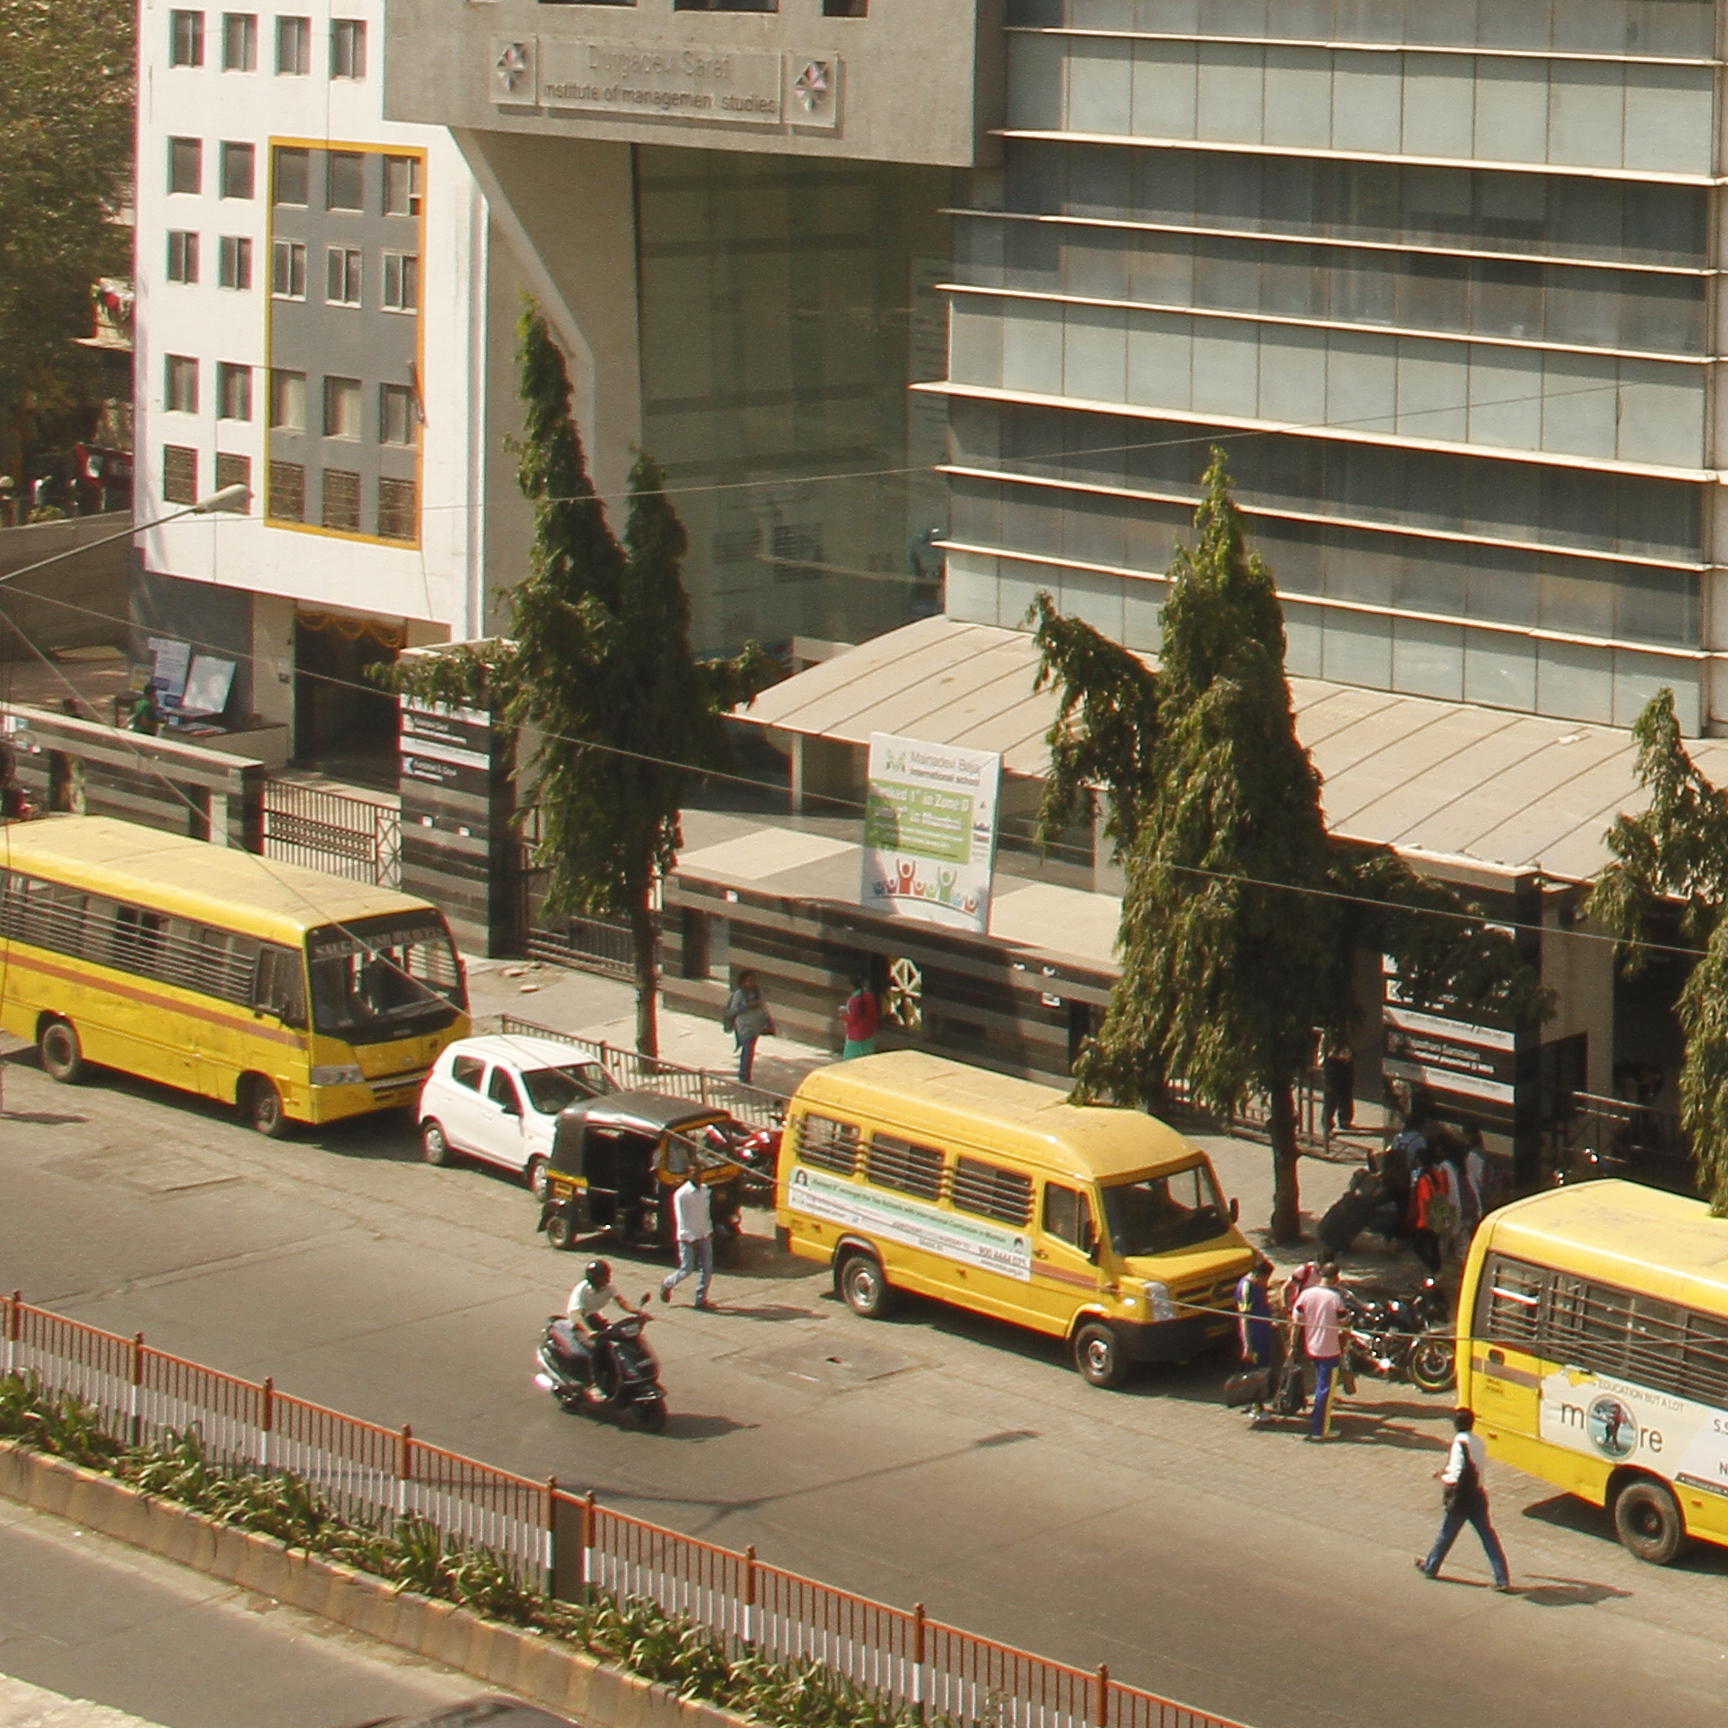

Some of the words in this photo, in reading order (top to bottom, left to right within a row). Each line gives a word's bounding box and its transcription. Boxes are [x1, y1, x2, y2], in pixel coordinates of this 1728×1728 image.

[603, 84, 618, 102] of
[621, 87, 717, 111] managemen
[720, 93, 777, 114] studies
[934, 793, 960, 812] Zone
[1599, 1379, 1644, 1403] EDUCATION
[1644, 1391, 1660, 1406] BUT
[1668, 1398, 1686, 1413] LOT
